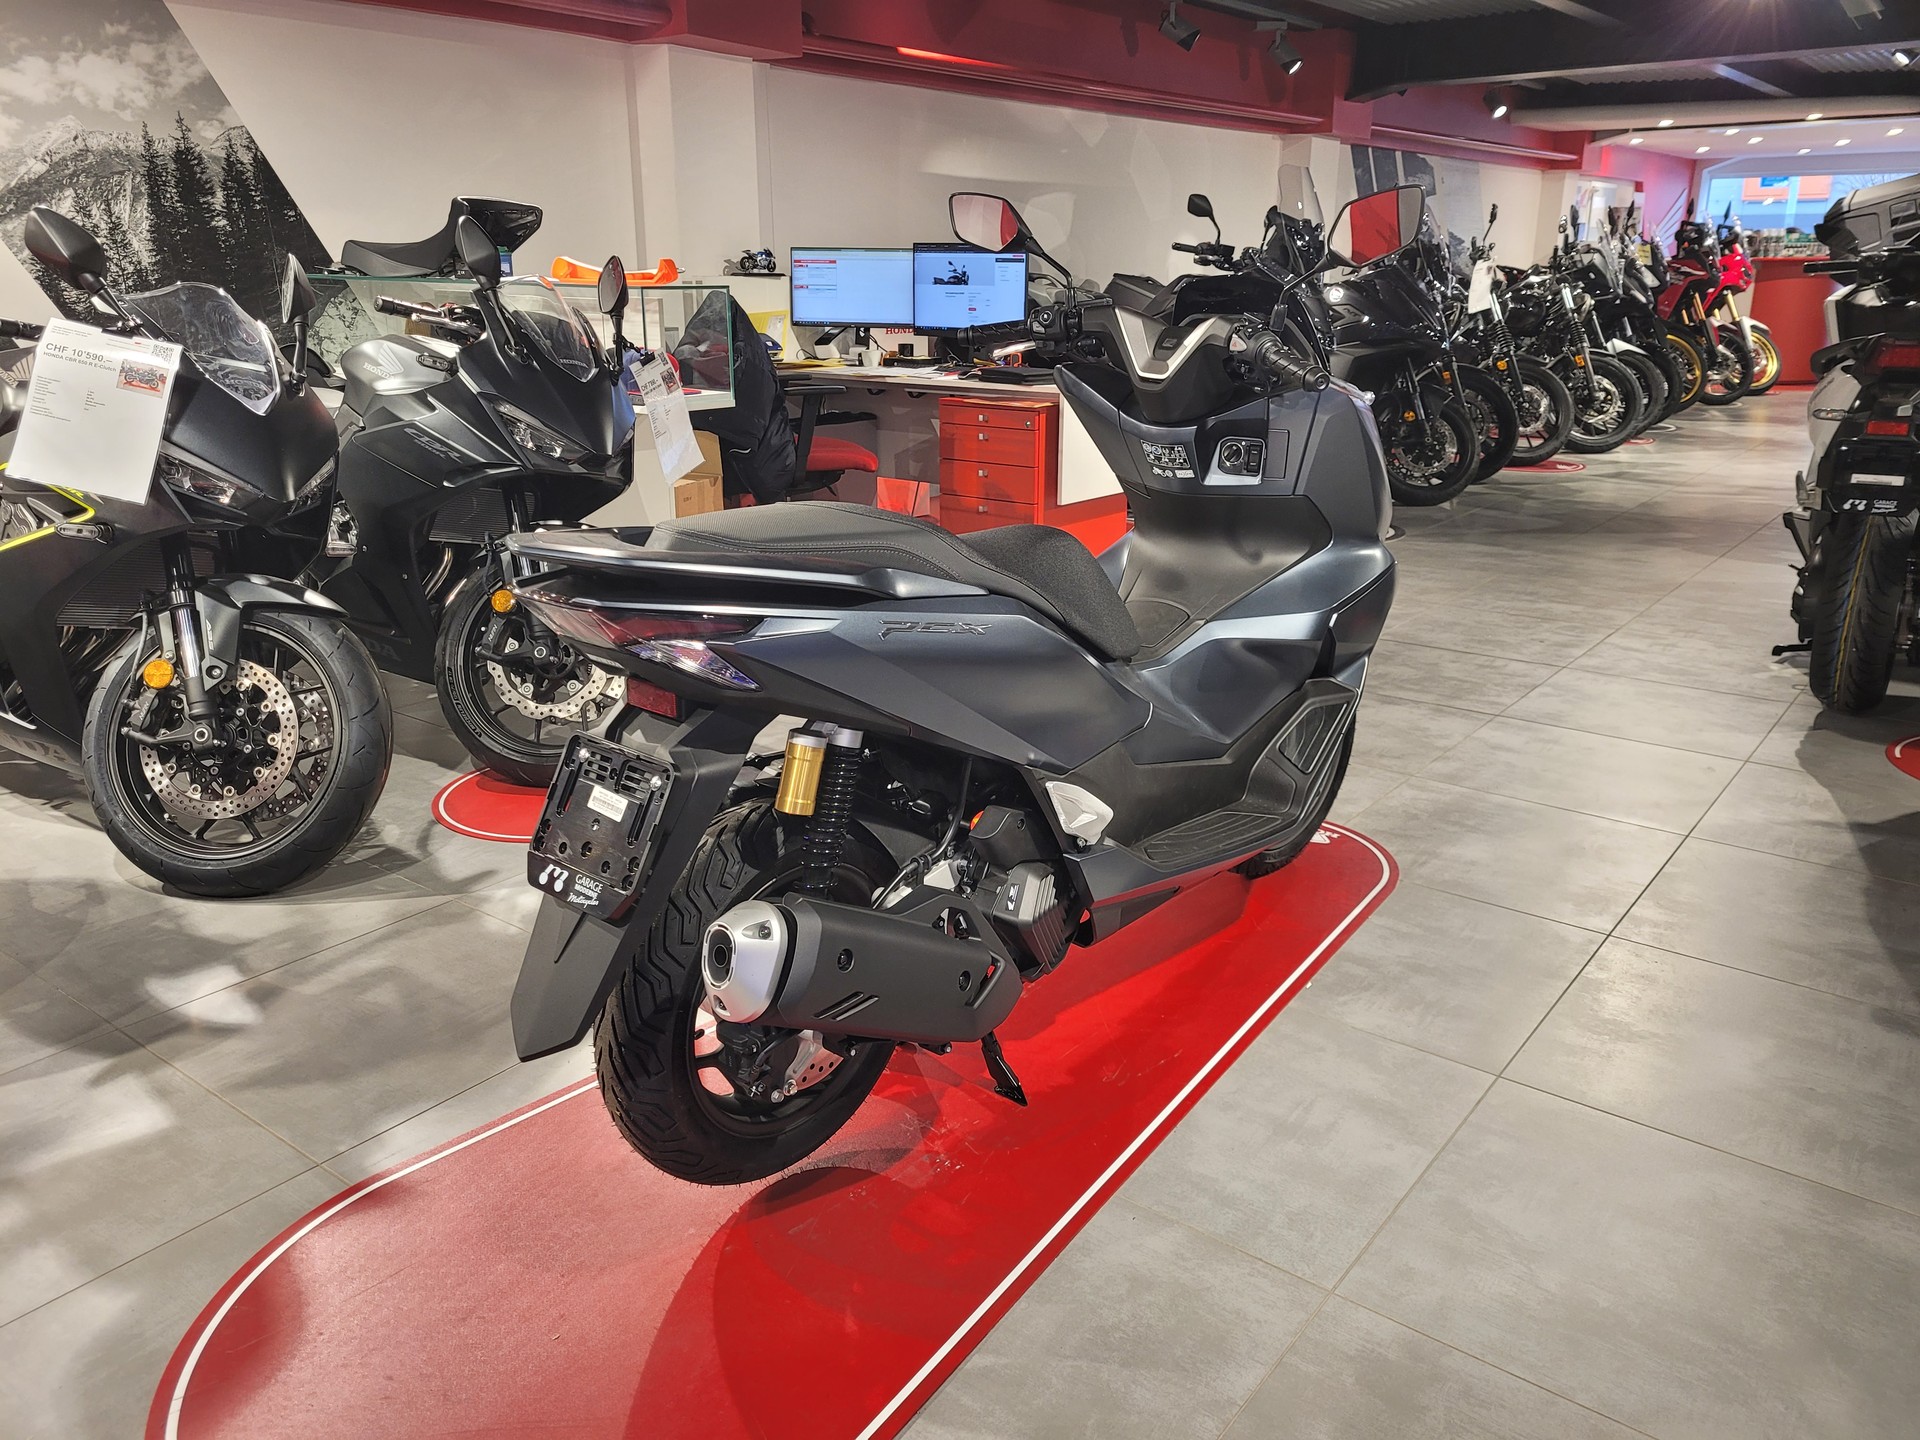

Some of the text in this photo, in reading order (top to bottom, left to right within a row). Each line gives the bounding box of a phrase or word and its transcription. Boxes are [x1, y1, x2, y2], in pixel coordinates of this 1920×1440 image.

[885, 327, 914, 335] HOND
[45, 342, 69, 354] CHF
[43, 351, 64, 360] HONDA
[94, 363, 117, 372] E-Clutch
[362, 362, 395, 380] HONDA
[0, 366, 19, 389] ONDA
[404, 427, 463, 464] CBR
[878, 620, 993, 641] PCX
[575, 874, 604, 894] GARAGE
